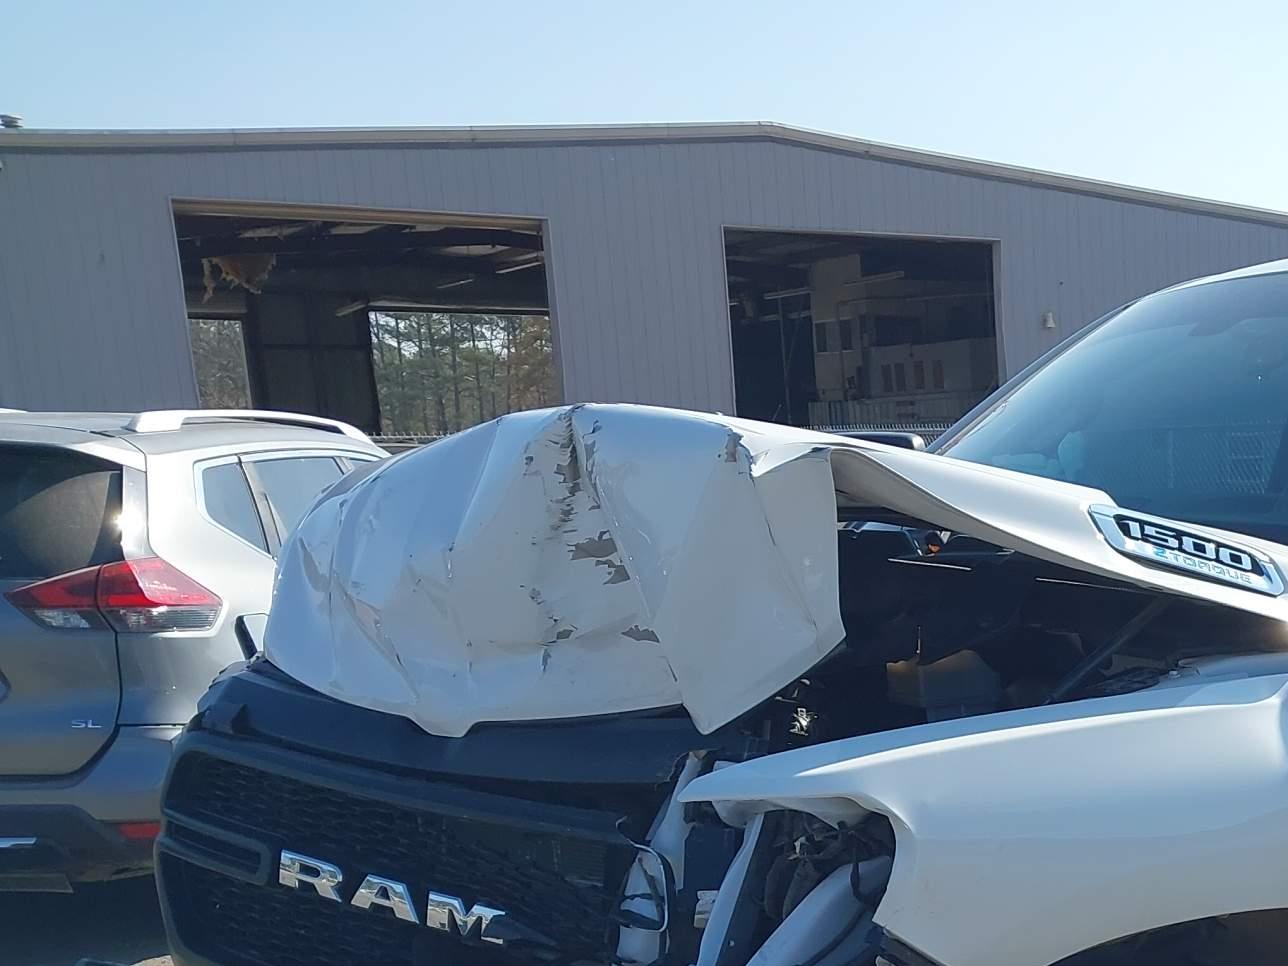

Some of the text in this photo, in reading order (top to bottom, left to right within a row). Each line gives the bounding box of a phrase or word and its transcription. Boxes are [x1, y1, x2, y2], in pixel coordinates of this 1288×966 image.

[1120, 520, 1253, 571] 1500
[71, 719, 105, 729] SL
[279, 849, 506, 945] RAM
